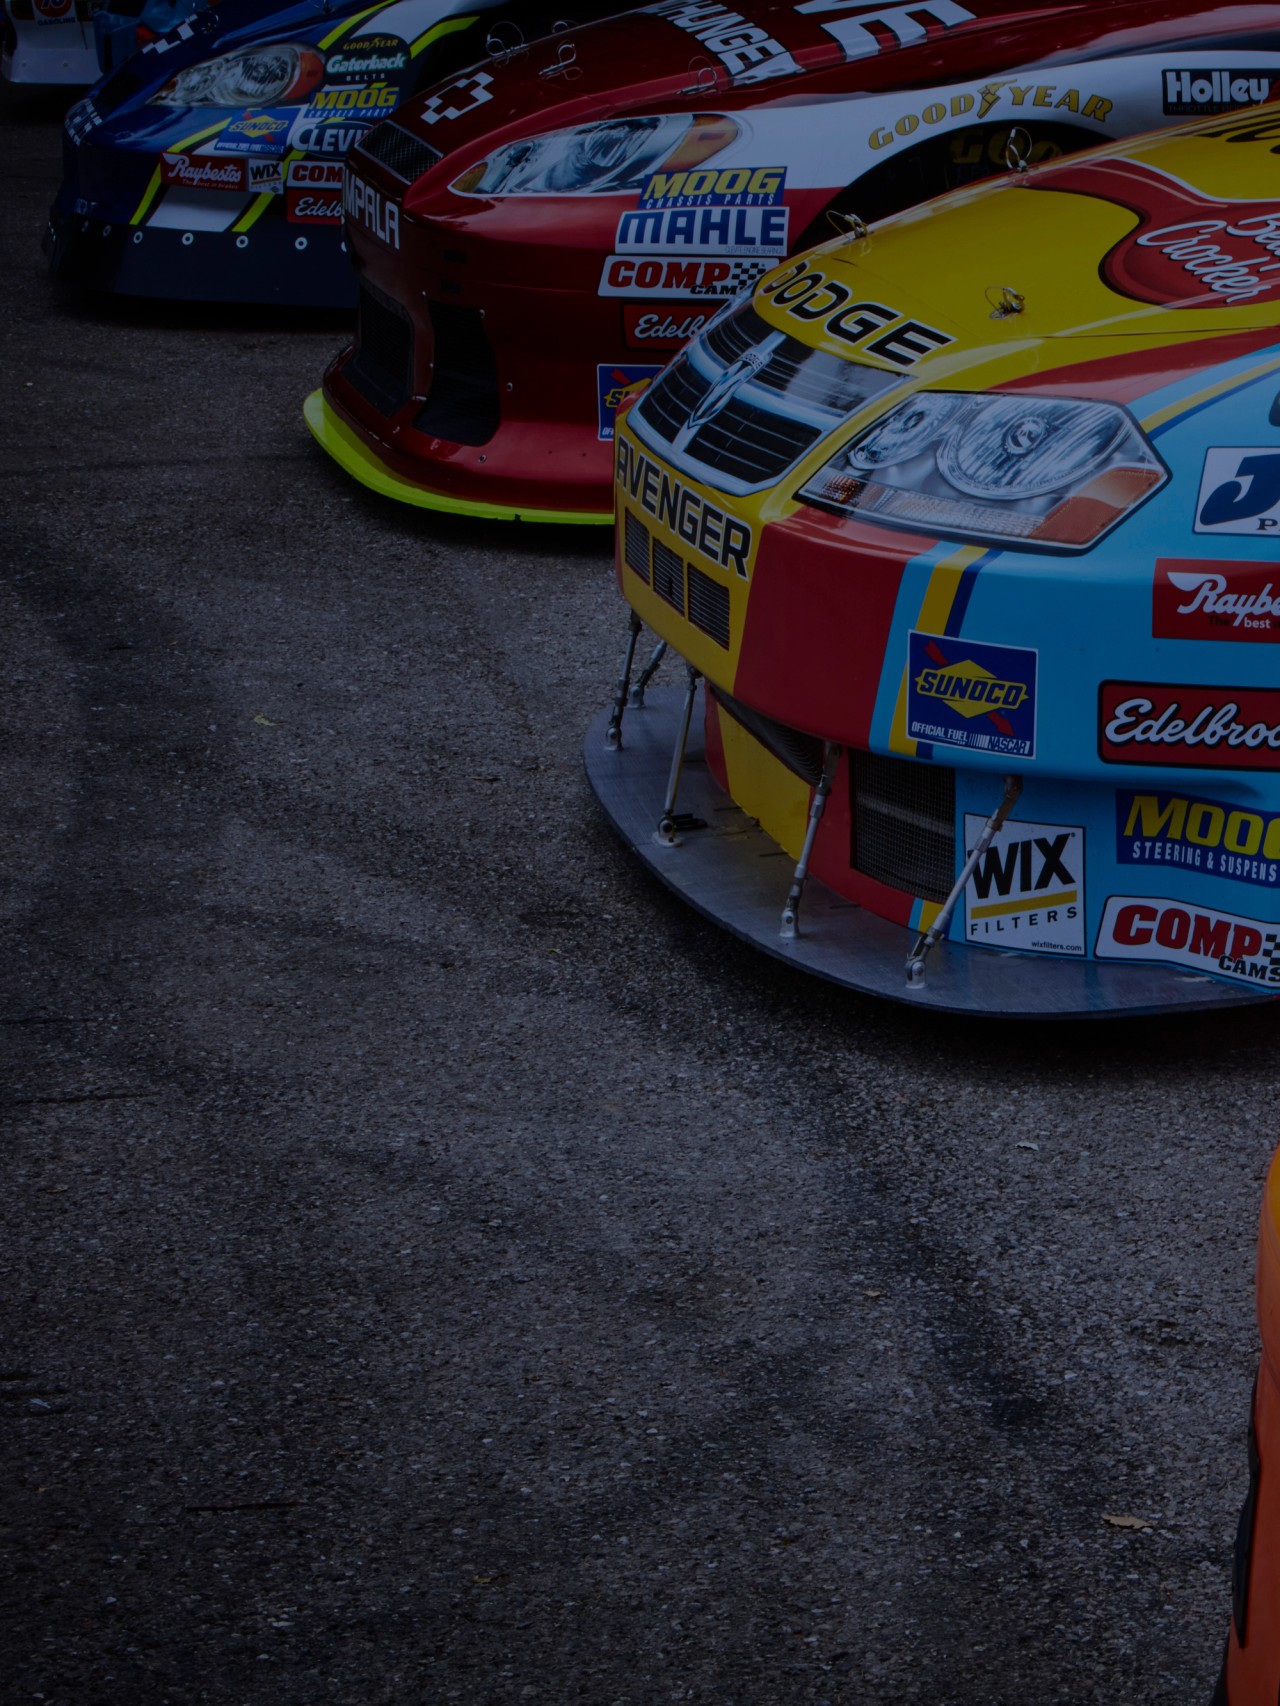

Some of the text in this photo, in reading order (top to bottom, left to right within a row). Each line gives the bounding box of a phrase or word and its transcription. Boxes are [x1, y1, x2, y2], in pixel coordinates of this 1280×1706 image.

[326, 52, 409, 73] Gatorback
[345, 73, 386, 82] BELTS
[1166, 70, 1270, 106] Holley
[309, 86, 400, 110] MOOG
[231, 120, 287, 132] SUNOCO
[162, 153, 242, 185] Raybestos
[250, 162, 281, 180] WIX
[642, 168, 785, 201] MOOG
[646, 193, 774, 210] CHASSIS PARTS
[618, 209, 786, 246] MAHLE
[608, 260, 730, 289] COMP
[1136, 219, 1272, 304] Crocker
[690, 285, 744, 295] CAM
[616, 435, 752, 579] AVENGER
[1244, 617, 1271, 629] best
[920, 671, 1024, 707] SUNOCO
[911, 721, 946, 739] OFFICIAL
[947, 728, 968, 742] FUEL
[967, 832, 1076, 899] WIX
[1132, 841, 1202, 867] STEERING
[1206, 851, 1214, 870] &
[971, 906, 1078, 936] FILTERS
[1112, 904, 1263, 964] COMP
[1031, 941, 1082, 952] wixfilters.com
